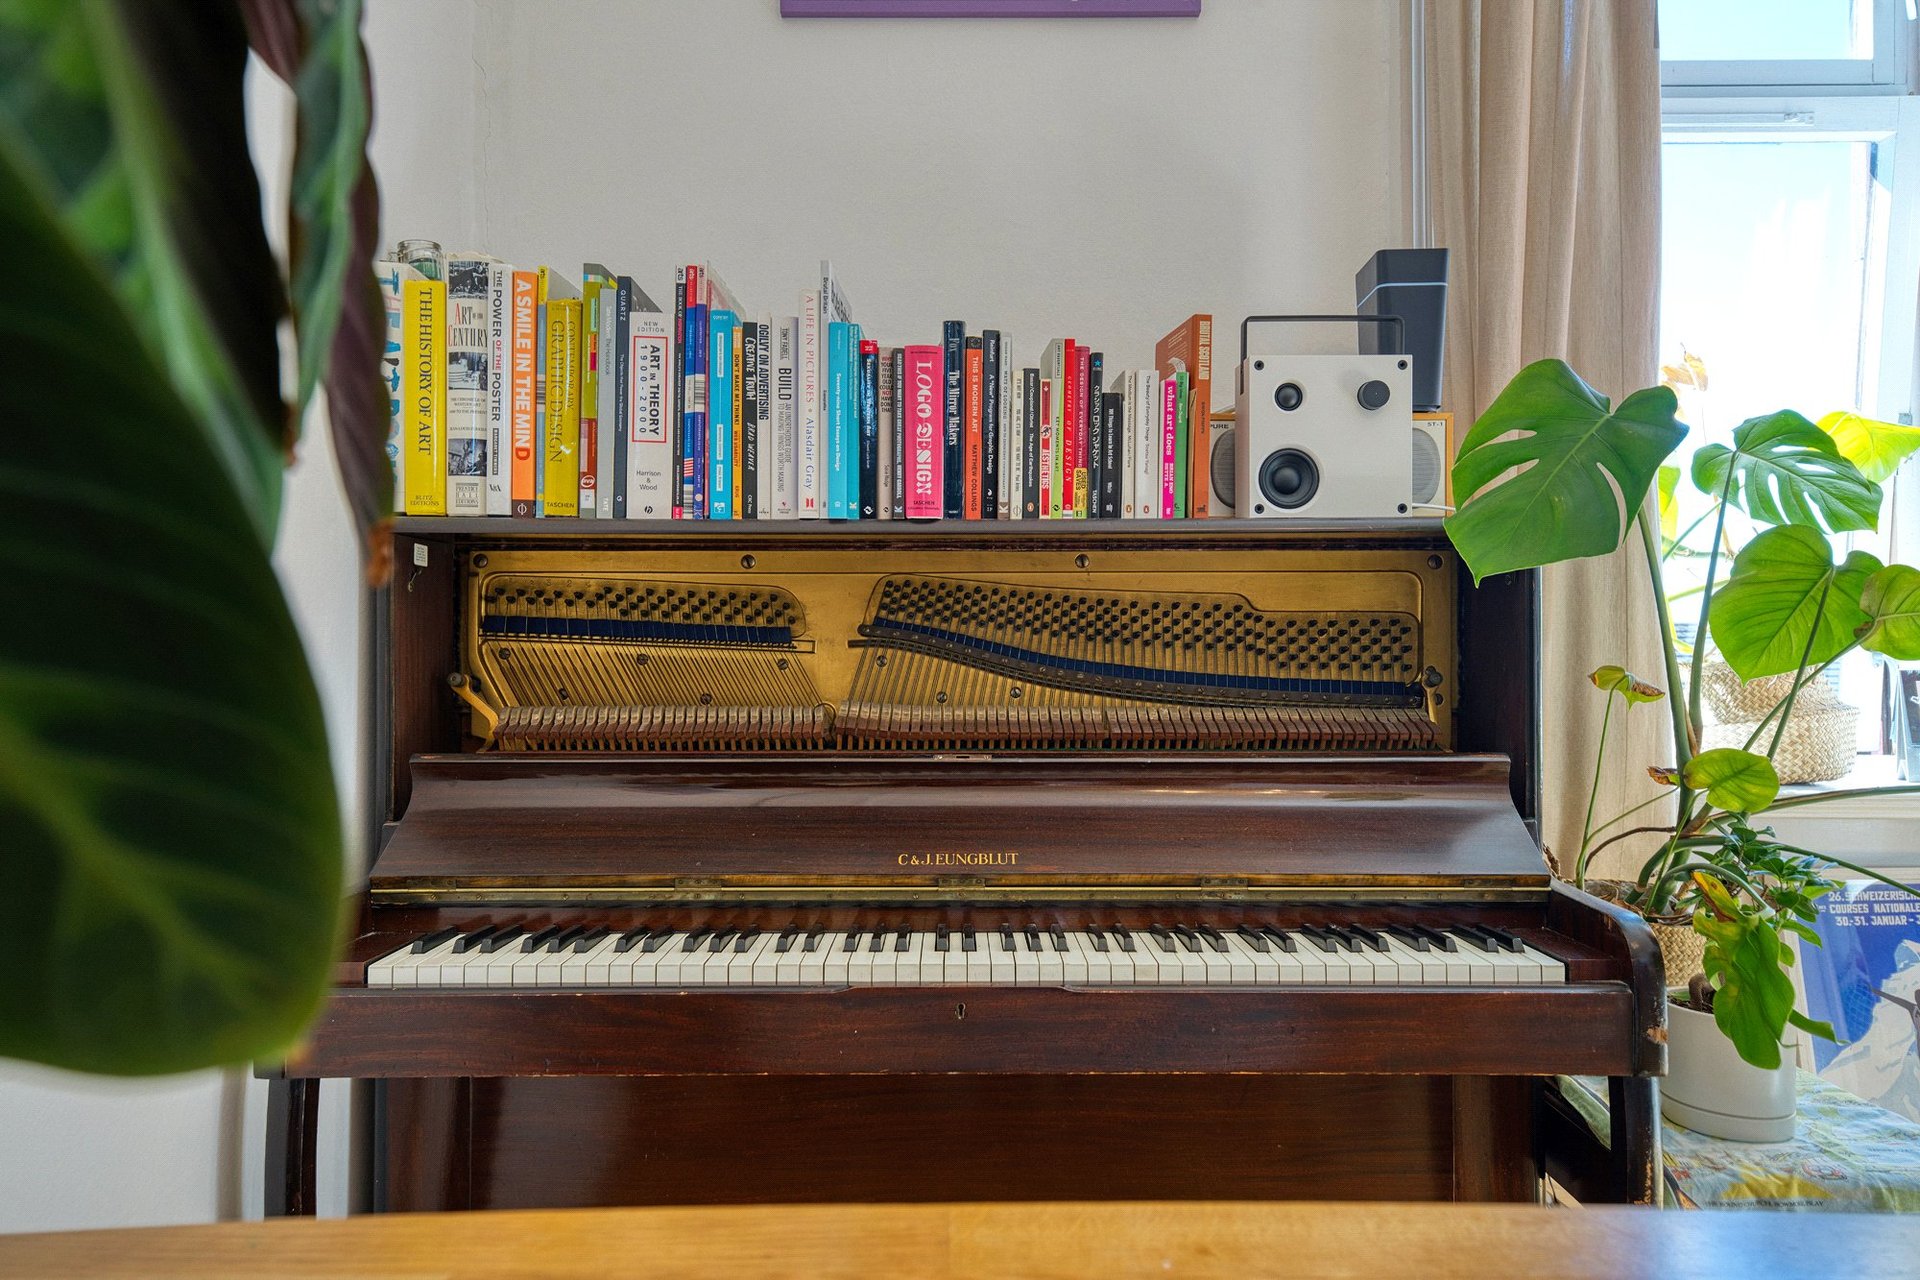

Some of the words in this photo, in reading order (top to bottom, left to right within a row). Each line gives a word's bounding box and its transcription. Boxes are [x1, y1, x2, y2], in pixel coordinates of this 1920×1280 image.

[516, 279, 532, 293] A
[419, 288, 433, 322] THE
[805, 295, 814, 304] A
[455, 302, 473, 325] ART
[492, 289, 503, 338] POWER
[516, 295, 532, 349] SMILE
[805, 307, 814, 329] LIFE
[447, 324, 488, 348] CENTURY
[758, 324, 769, 353] OGILVY
[781, 328, 789, 341] TONY
[805, 333, 814, 345] IN
[1199, 320, 1211, 345] BRUTAL
[495, 340, 502, 351] OF
[745, 337, 757, 372] CREATIVE
[781, 341, 789, 360] FADELL
[419, 324, 433, 394] HISTORY
[516, 353, 532, 372] IN
[550, 320, 565, 397] GRAPHIC
[605, 349, 613, 375] Handbook
[649, 344, 660, 371] ART
[758, 354, 769, 366] ON
[971, 356, 979, 374] THIS
[1199, 346, 1211, 380] SCOTLAND
[650, 373, 656, 381] IN
[745, 374, 757, 401] TRUTH
[778, 367, 792, 400] BUILD
[805, 350, 814, 403] PICTURES
[948, 370, 960, 386] The
[971, 375, 979, 383] IS
[491, 372, 501, 422] POSTER
[516, 375, 532, 412] THE
[734, 393, 740, 402] ME
[758, 367, 769, 420] ADVERTISING
[916, 360, 933, 419] LOGO
[948, 387, 960, 415] Mirror
[1166, 385, 1174, 413] what
[419, 397, 433, 418] OF
[649, 383, 660, 436] THEORY
[777, 403, 785, 411] TO
[784, 402, 792, 411] AN
[986, 399, 994, 423] Program
[1078, 399, 1084, 409] OF
[549, 400, 563, 463] DESIGN
[746, 422, 755, 441] BRAD
[777, 411, 785, 431] MAKING
[948, 416, 960, 446] Makers
[1166, 414, 1174, 430] art
[419, 421, 433, 456] ART
[515, 413, 531, 461] MIND
[777, 432, 785, 451] THINGS
[805, 417, 814, 461] Alasdair
[835, 444, 842, 452] on
[985, 432, 994, 454] Graphic
[1166, 432, 1174, 456] does
[746, 443, 755, 471] WEAVER
[777, 452, 785, 471] WORTH
[916, 421, 933, 496] DESIGN
[985, 454, 993, 475] Design
[777, 471, 785, 492] MAKING
[803, 465, 814, 490] Gray
[897, 853, 909, 866] C
[910, 854, 920, 866] &
[920, 853, 934, 866] J.
[935, 852, 1019, 866] EUNGBLUT
[1828, 891, 1845, 902] 26.
[1829, 903, 1869, 914] COURSES
[1871, 915, 1908, 926] JANUAR
